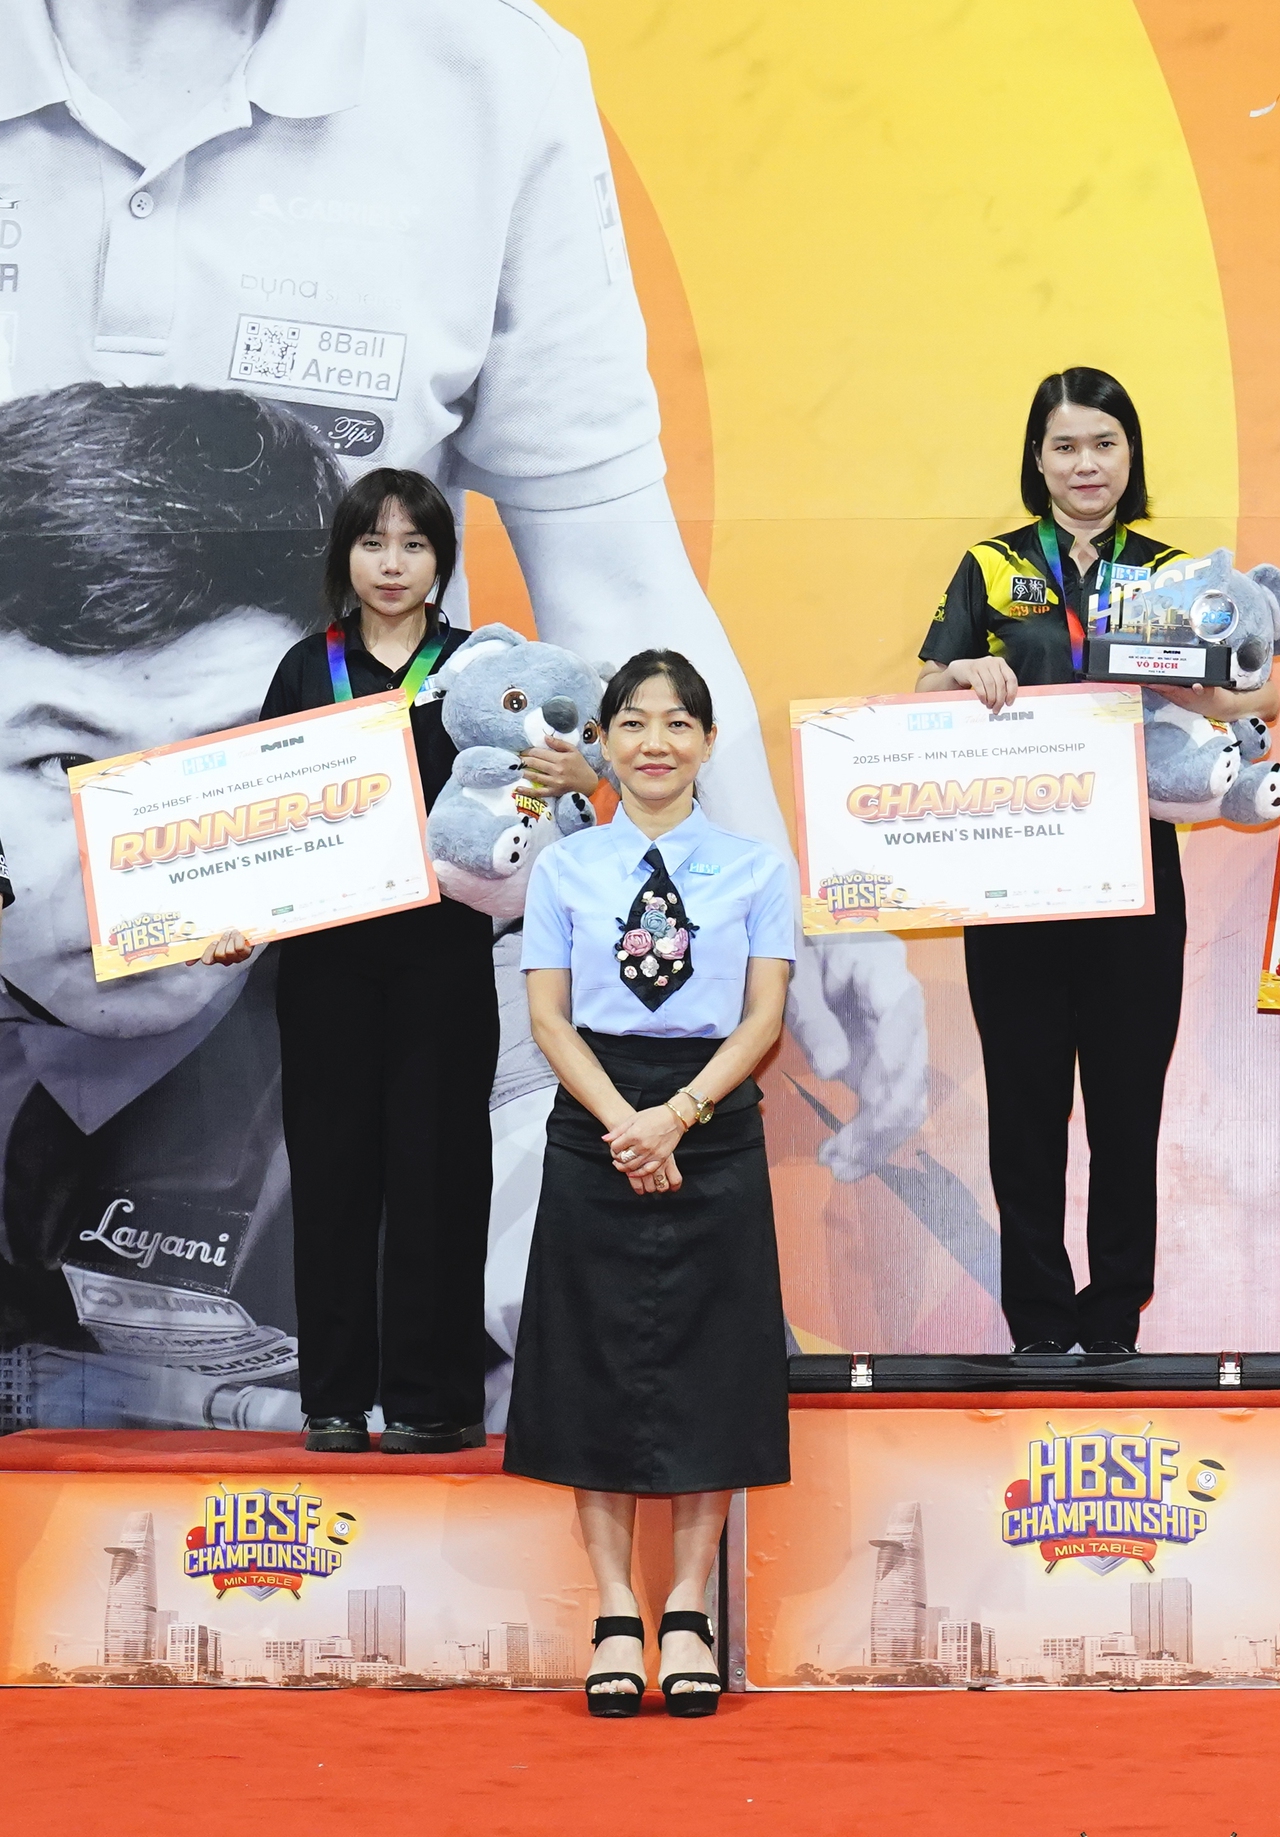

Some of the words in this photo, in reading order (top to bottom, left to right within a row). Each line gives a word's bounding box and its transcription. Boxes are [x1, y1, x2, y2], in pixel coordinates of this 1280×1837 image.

[318, 331, 386, 358] 8Ball
[301, 358, 391, 391] Arena
[328, 416, 377, 449] Tips
[1201, 611, 1232, 625] 2025
[1136, 660, 1150, 668] VÔ
[1153, 661, 1178, 670] ĐỊCH
[908, 713, 951, 731] HBSF
[988, 711, 1034, 722] MIN
[260, 736, 305, 753] MIN
[853, 755, 880, 764] 2025
[883, 753, 915, 763] HBSF
[925, 752, 948, 760] MIN
[950, 748, 989, 759] TABLE
[991, 742, 1086, 757] CHAMPIONSHIP
[132, 803, 160, 816] 2025
[162, 795, 192, 809] HBSF
[202, 788, 225, 799] MIN
[227, 777, 264, 793] TABLE
[266, 755, 357, 784] CHAMPIONSHIP
[846, 772, 1096, 823] CHAMPION
[109, 772, 392, 872] RUNNER-UP
[884, 827, 970, 846] WOMEN'S
[973, 823, 1065, 841] NINE-BALL
[168, 855, 252, 885] WOMEN'S
[254, 834, 345, 865] NINE-BALL
[827, 883, 887, 912] HBSF
[117, 920, 176, 956] HBSF
[79, 1198, 230, 1268] Layani
[1029, 1434, 1180, 1503] HBSF
[1203, 1473, 1212, 1484] 9
[205, 1492, 322, 1545] HBSF
[1002, 1500, 1207, 1544] CHAMPIONSHIP
[184, 1543, 342, 1577] CHAMPIONSHIP
[1054, 1543, 1085, 1556] MIN
[1089, 1543, 1144, 1556] TABLE
[224, 1575, 249, 1586] MIN
[250, 1575, 293, 1587] TABLE
